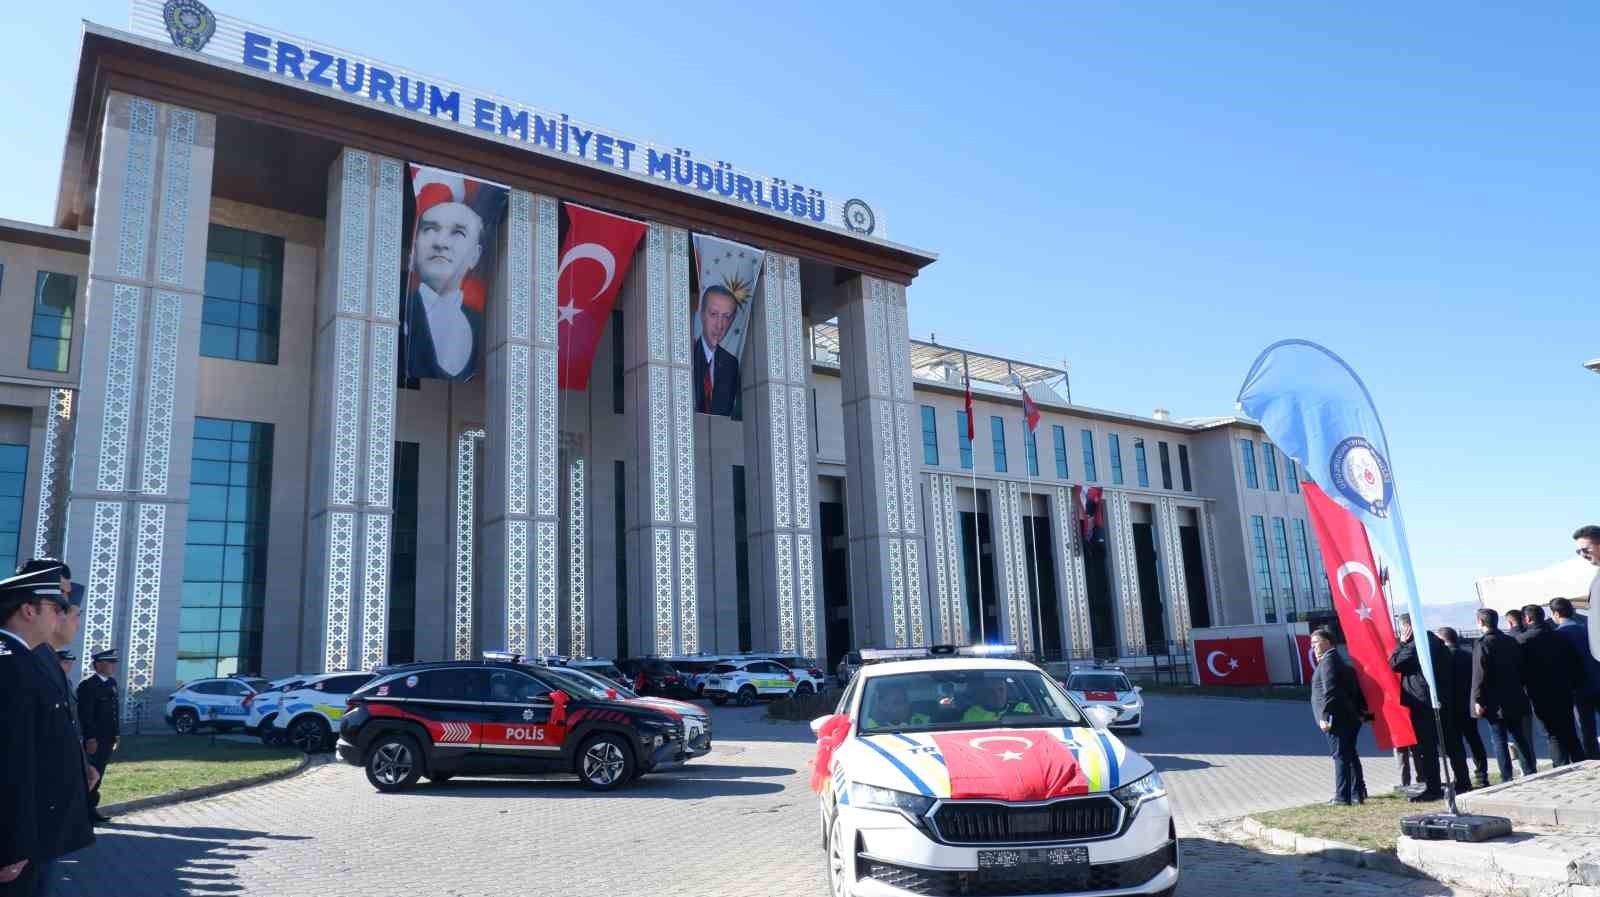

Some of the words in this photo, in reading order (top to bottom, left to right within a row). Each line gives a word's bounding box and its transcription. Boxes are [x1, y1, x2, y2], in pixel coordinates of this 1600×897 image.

[243, 31, 461, 123] ERZURUM
[474, 97, 636, 170] EMNİYET
[647, 148, 826, 223] MÜDÜRLÜĞÜ
[505, 726, 545, 741] POLİS
